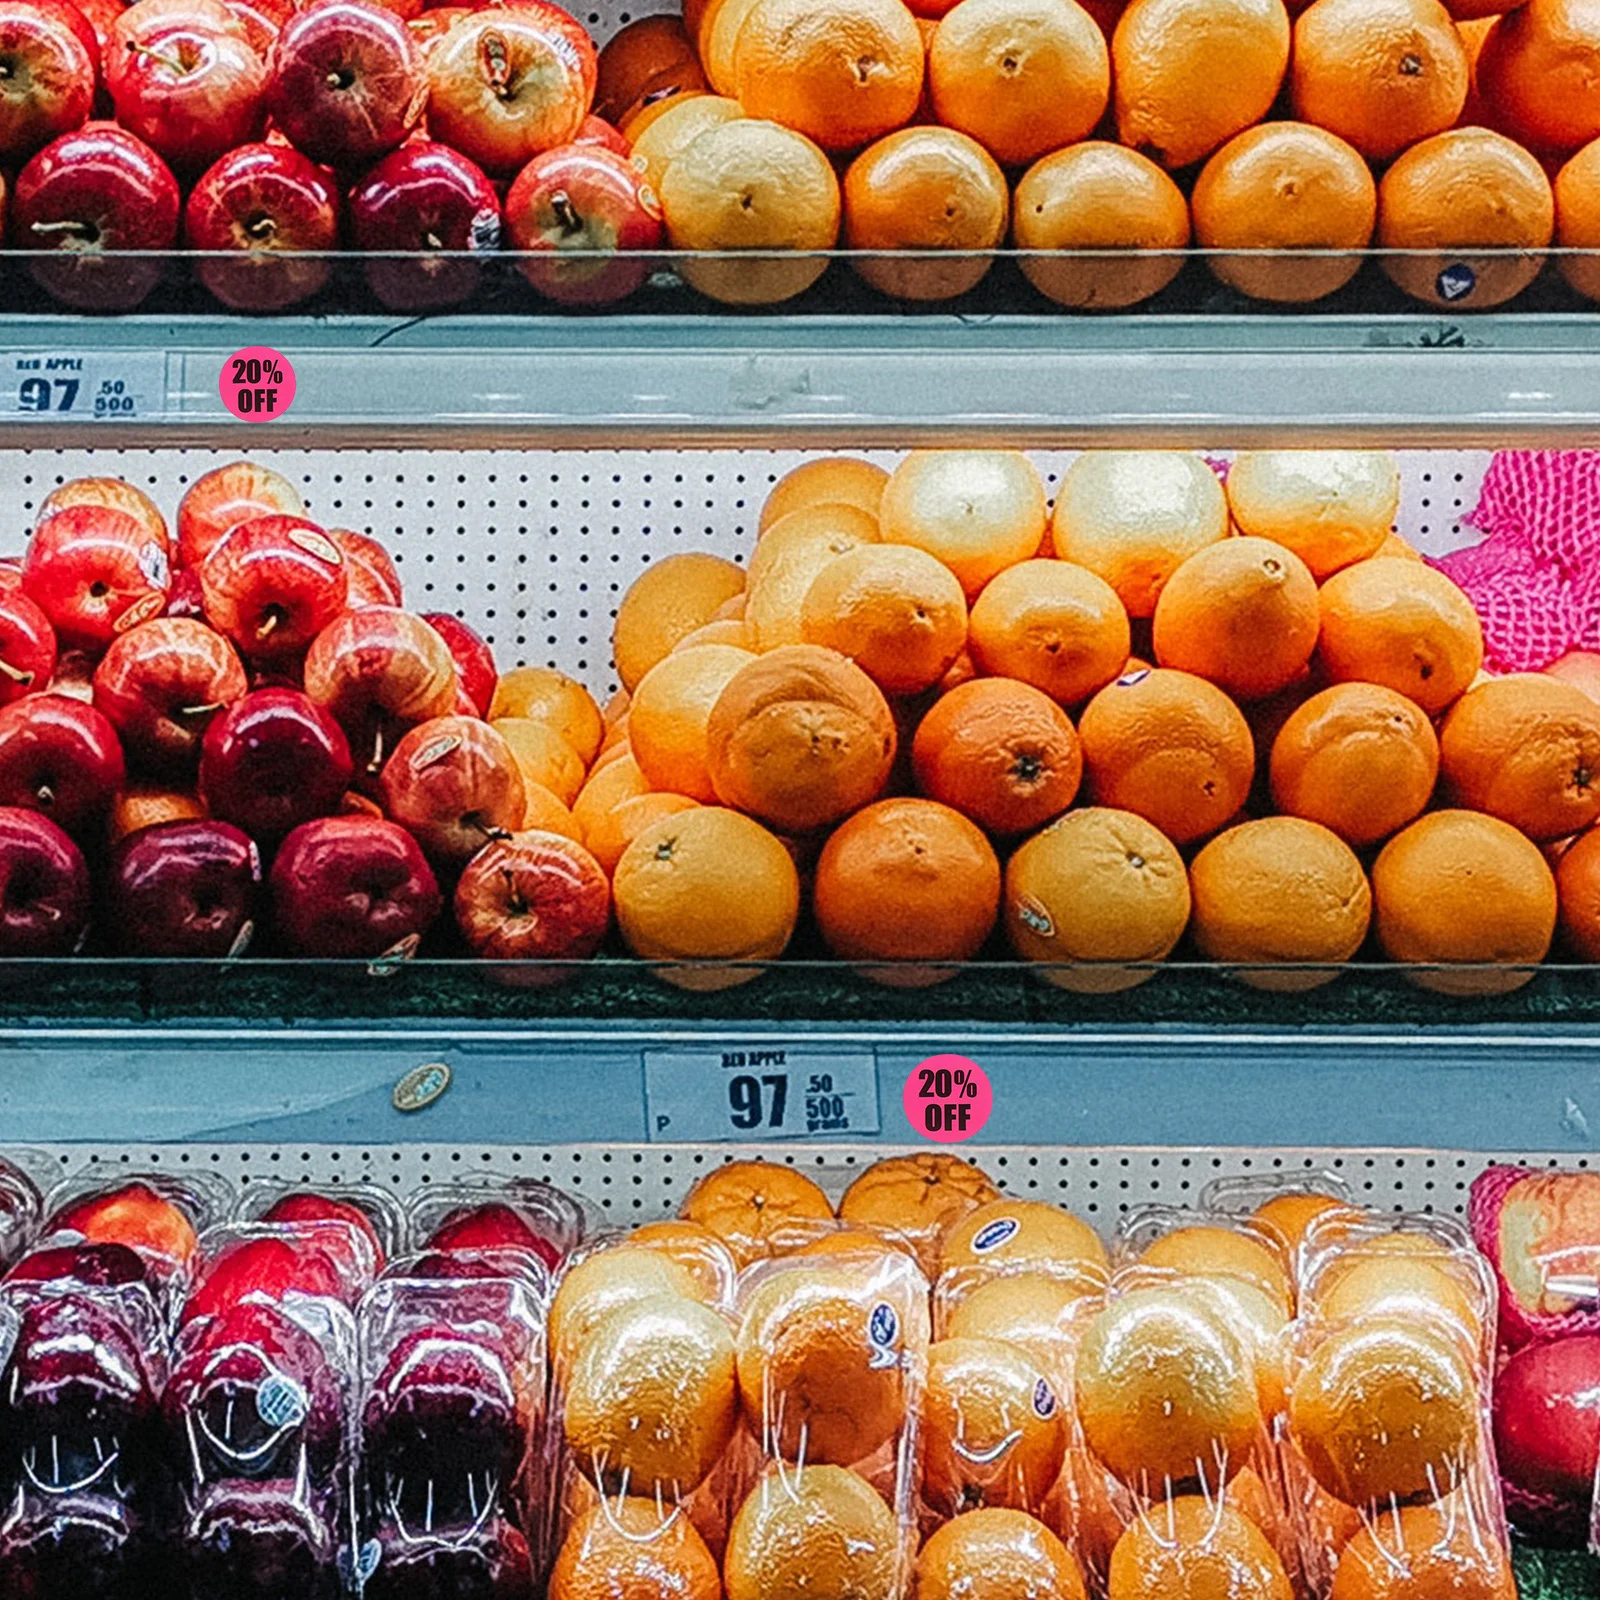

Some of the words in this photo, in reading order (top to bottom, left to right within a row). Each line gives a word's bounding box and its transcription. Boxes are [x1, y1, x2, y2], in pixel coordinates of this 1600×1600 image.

[45, 359, 83, 371] APPLE
[232, 359, 283, 384] 20%
[18, 378, 80, 411] 97
[95, 397, 134, 410] 500
[238, 389, 277, 412] OFF
[749, 1051, 786, 1066] APPLE
[918, 1069, 977, 1098] 20%
[729, 1075, 787, 1129] 97
[806, 1096, 844, 1119] 500
[657, 1116, 670, 1132] P
[925, 1104, 970, 1131] OFF
